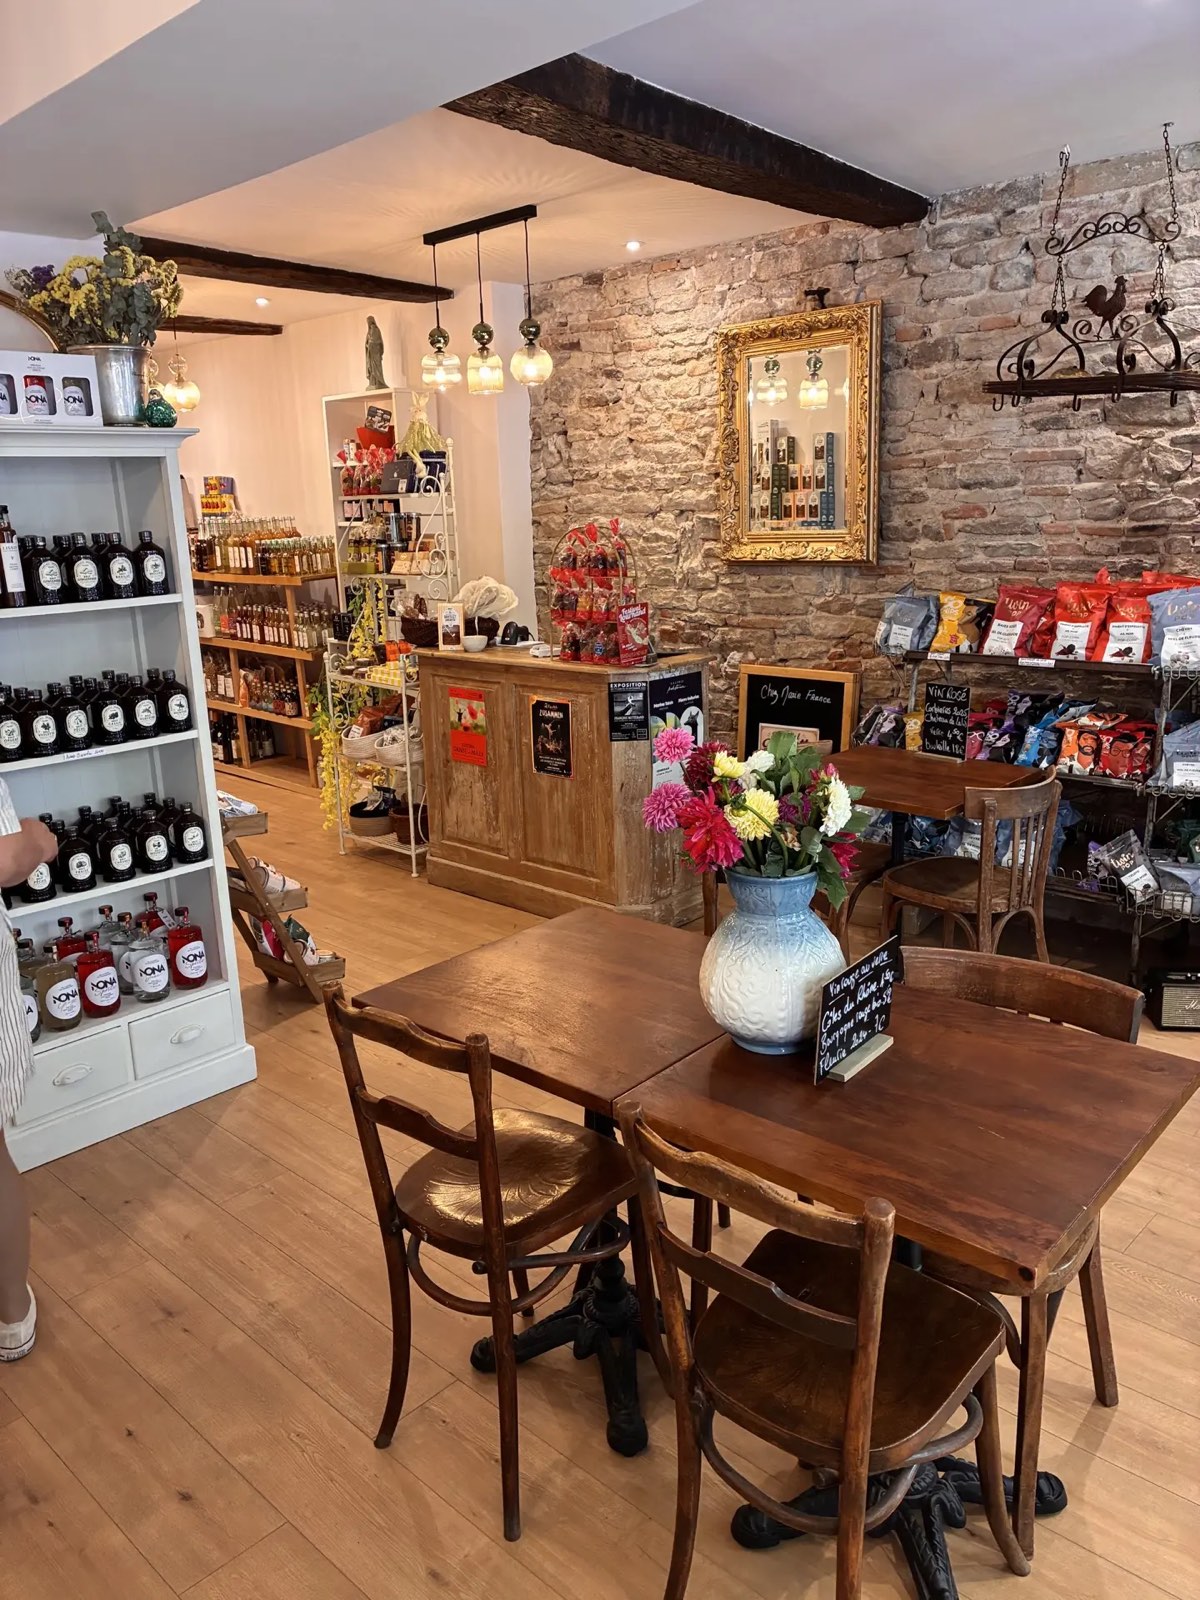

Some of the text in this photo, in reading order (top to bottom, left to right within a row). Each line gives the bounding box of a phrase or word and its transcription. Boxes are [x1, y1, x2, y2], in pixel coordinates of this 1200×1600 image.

[761, 683, 778, 705] Chez
[539, 709, 563, 719] ZUSAMMEN
[1110, 851, 1135, 869] twin
[1121, 860, 1134, 871] POP
[830, 951, 888, 997] Vin rouge au verre
[844, 995, 855, 1014] du
[820, 1019, 854, 1056] Bourgogne
[856, 1004, 871, 1022] rouge
[819, 1048, 847, 1076] Fleurie
